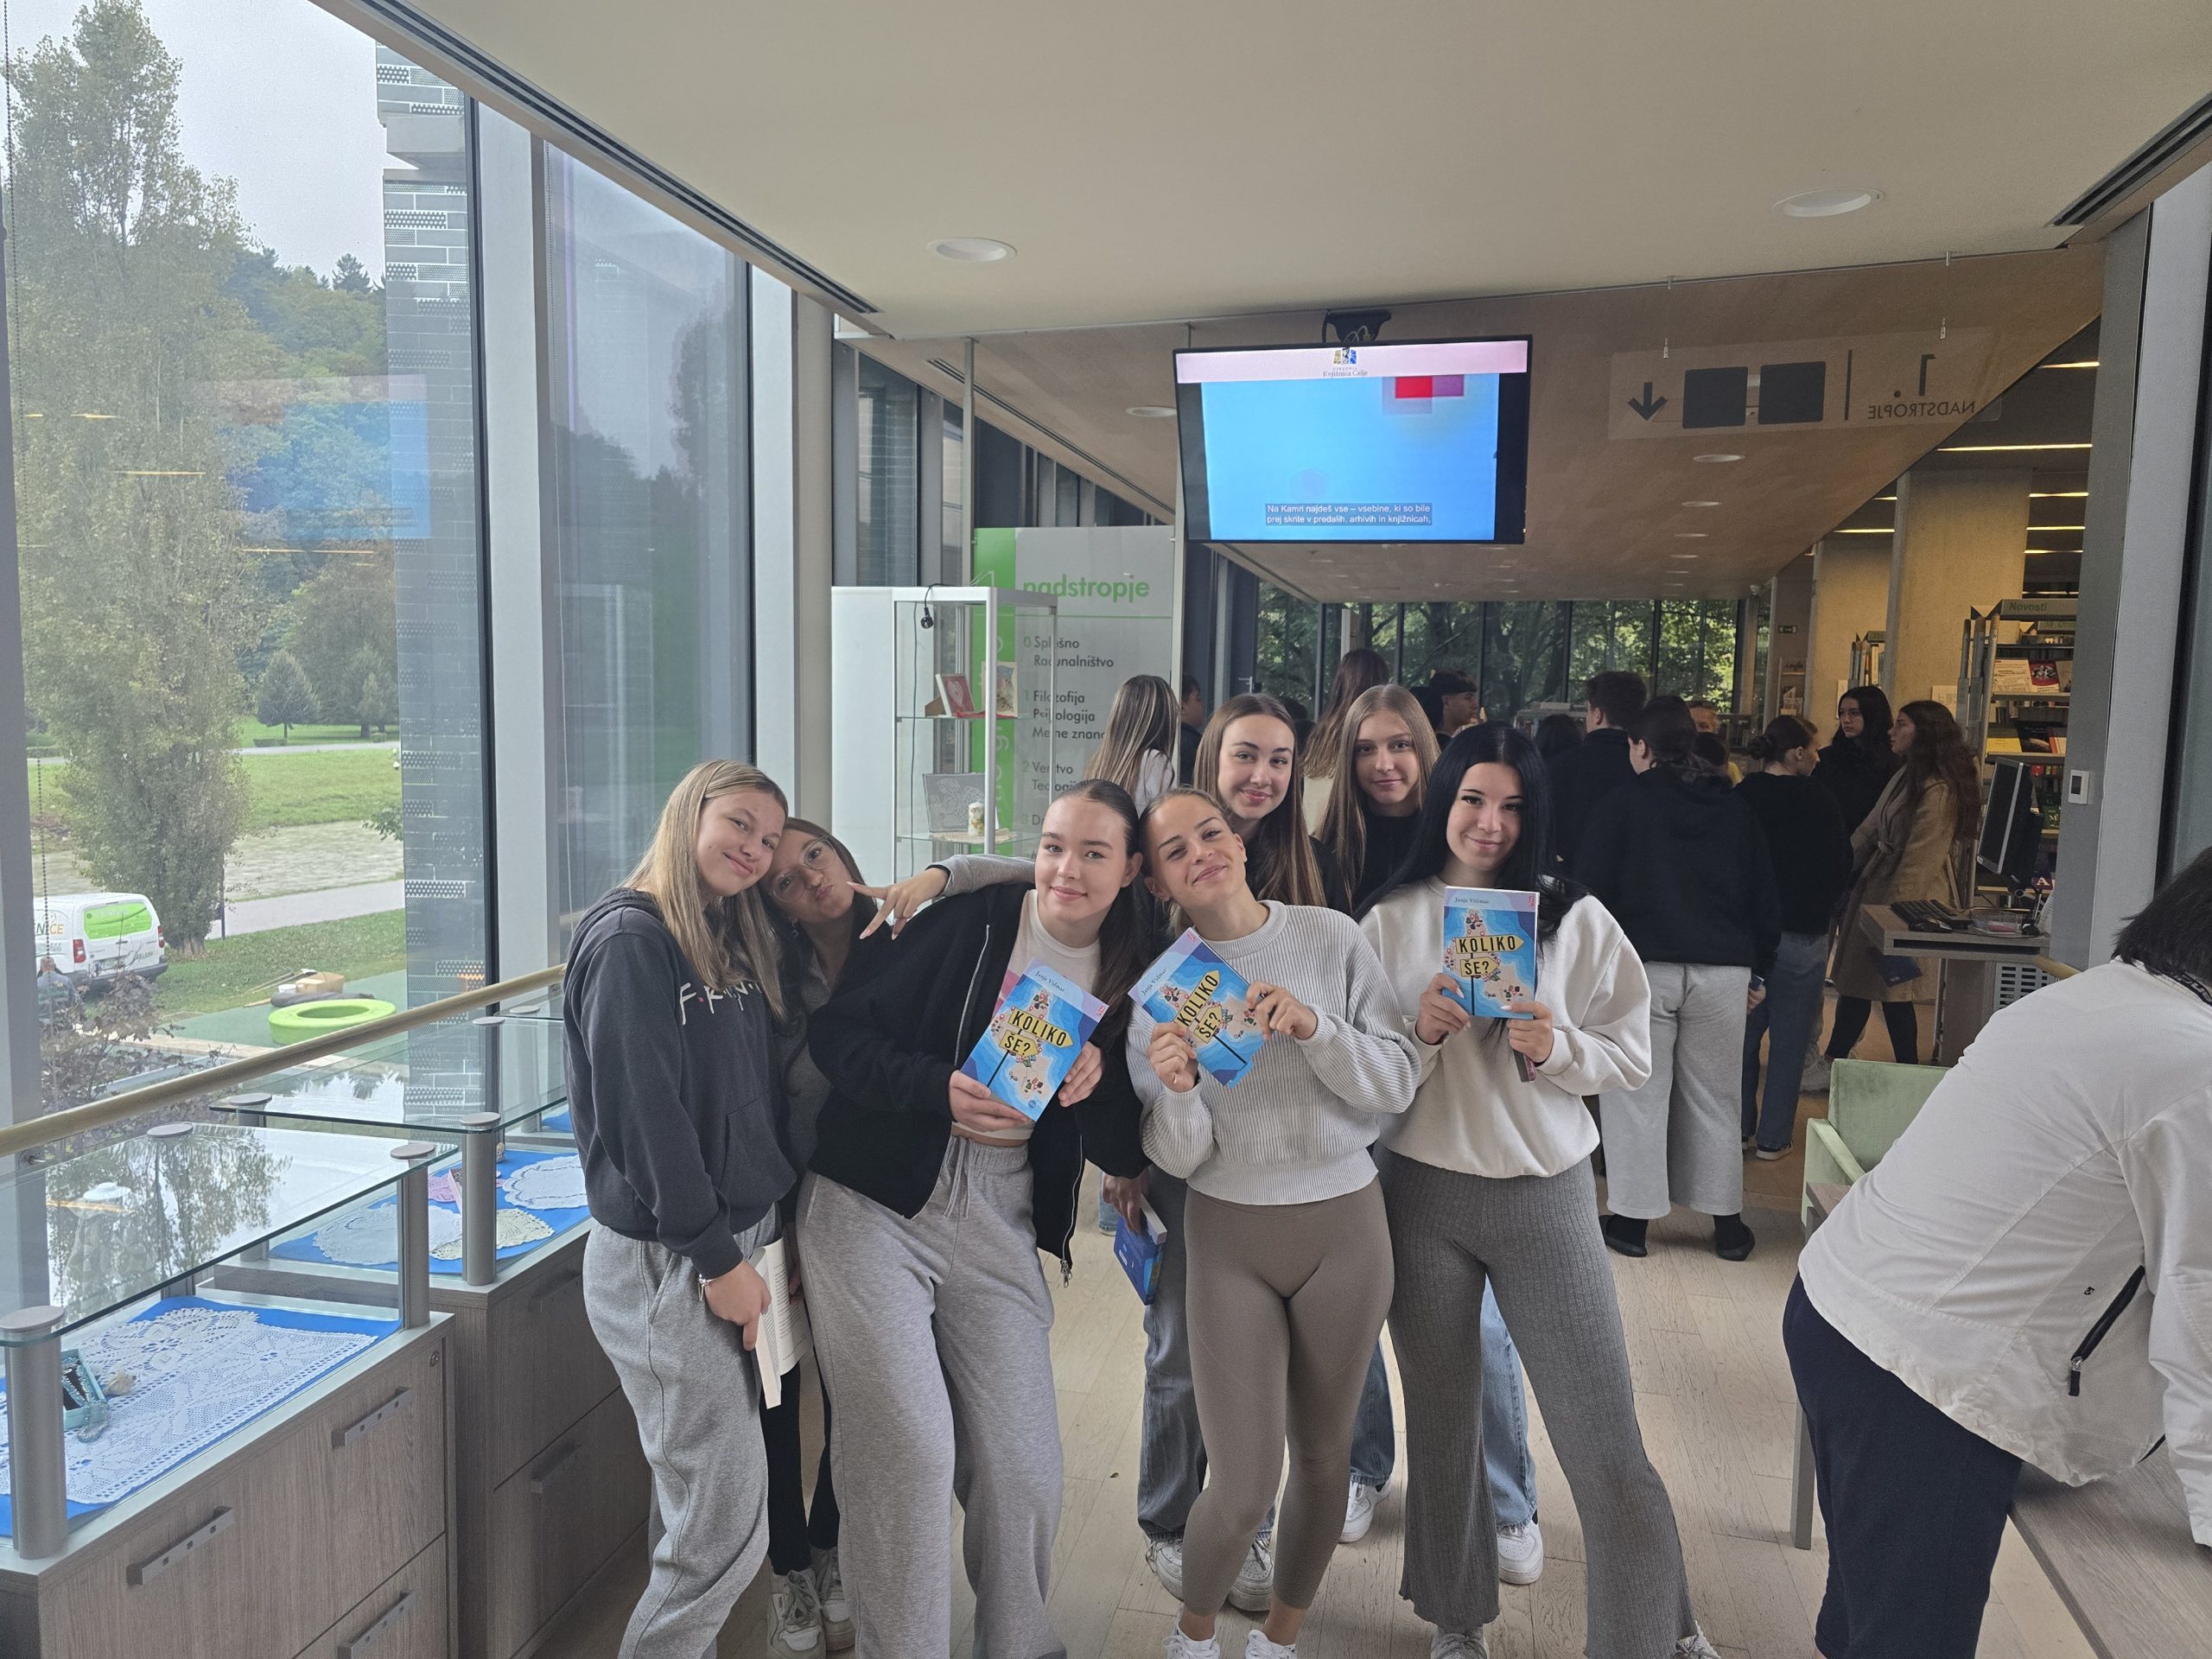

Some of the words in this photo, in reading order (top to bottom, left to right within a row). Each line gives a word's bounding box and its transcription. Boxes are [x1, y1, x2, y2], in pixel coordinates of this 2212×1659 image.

[1306, 505, 1332, 514] najdeš
[1357, 505, 1392, 513] vsebine,
[1415, 504, 1430, 512] bile
[1267, 516, 1281, 524] prej
[1313, 516, 1348, 524] predalih,
[1388, 515, 1431, 524] knjižnicah,
[1023, 574, 1149, 603] nadstropje
[2009, 602, 2047, 611] Novosti
[1033, 635, 1079, 651] Splšno
[1032, 727, 1068, 739] Mene
[1032, 762, 1073, 774] Vertvo
[1459, 936, 1516, 953] KOLIKO
[1464, 958, 1490, 976] ŠE?
[1177, 975, 1218, 1027] KOLIKO
[1012, 1010, 1067, 1046] KOLIKO
[1196, 1012, 1222, 1039] ŠE?
[1004, 1033, 1031, 1056] ŠE?
